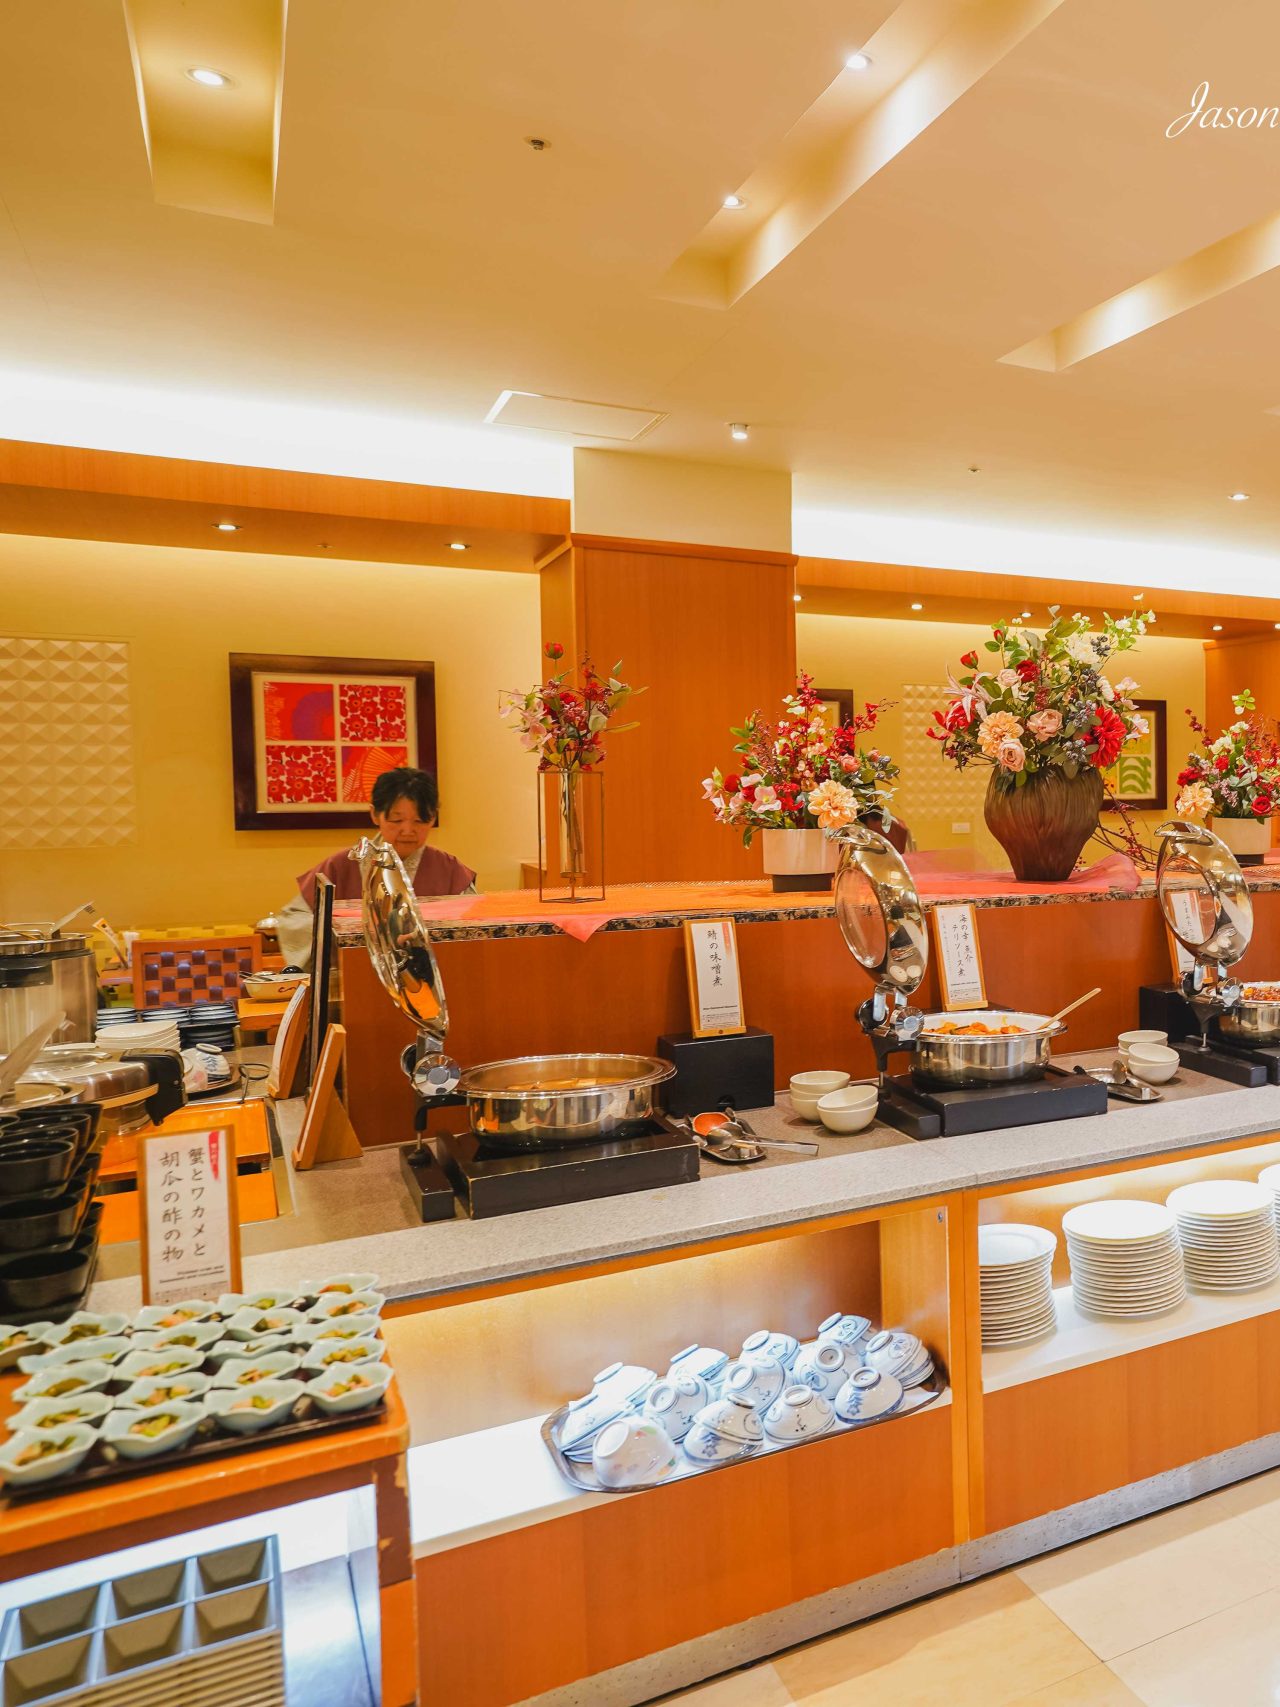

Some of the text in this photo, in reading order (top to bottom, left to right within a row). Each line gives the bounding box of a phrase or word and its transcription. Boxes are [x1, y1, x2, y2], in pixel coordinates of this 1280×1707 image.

[707, 929, 723, 987] 鯖の味噌煮
[159, 1151, 184, 1263] 胡瓜の酢の物
[188, 1147, 206, 1257] 蟹とワカメと
